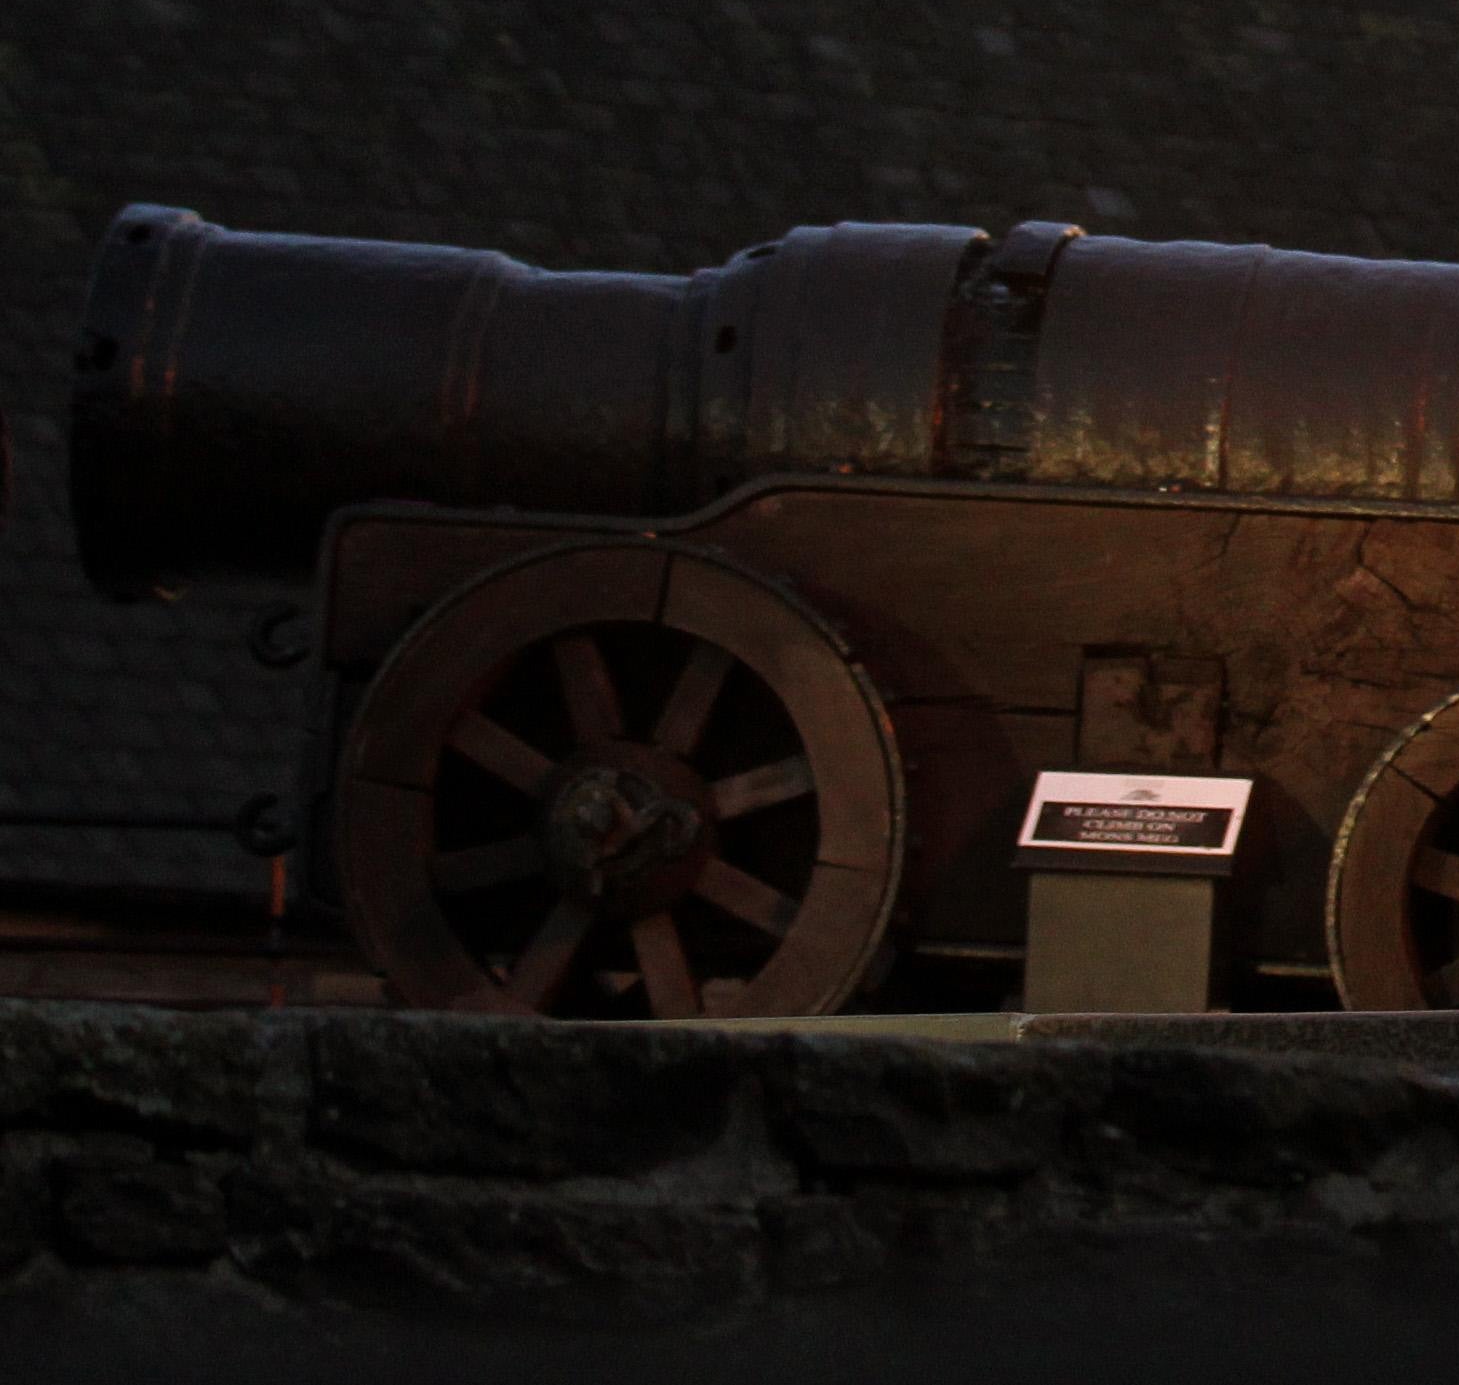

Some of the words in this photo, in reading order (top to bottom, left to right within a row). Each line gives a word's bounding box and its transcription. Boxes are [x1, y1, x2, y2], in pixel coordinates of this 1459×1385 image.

[1064, 807, 1130, 818] PLEASE
[1136, 809, 1165, 820] DO
[1166, 811, 1206, 823] NOT
[1082, 819, 1143, 830] CLIMB
[1146, 821, 1175, 832] ON
